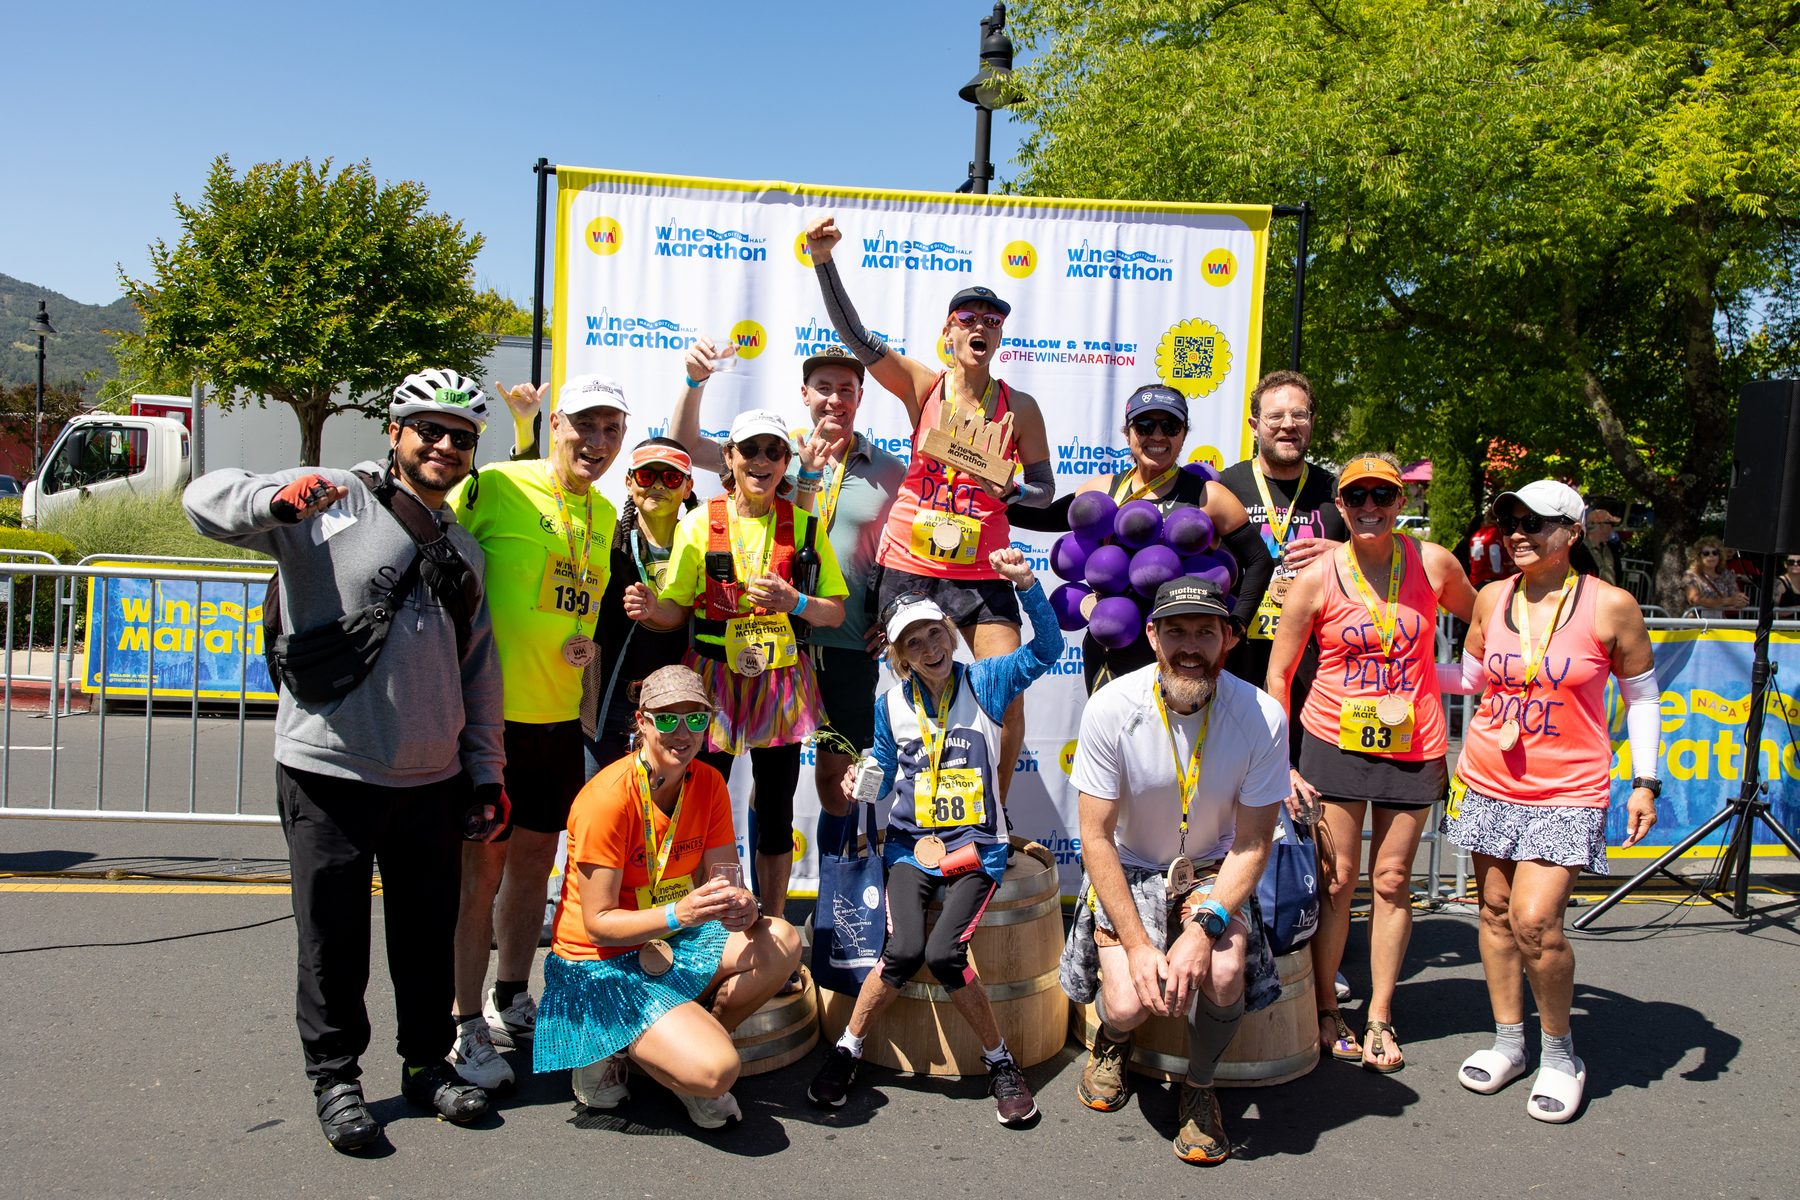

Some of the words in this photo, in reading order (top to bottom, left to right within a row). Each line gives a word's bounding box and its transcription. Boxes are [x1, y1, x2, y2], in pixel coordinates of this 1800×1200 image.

[723, 231, 747, 241] EDITION
[1000, 337, 1061, 349] FOLLOW
[1066, 339, 1077, 350] &
[1083, 340, 1111, 351] TAG
[1114, 342, 1138, 353] US!
[999, 350, 1136, 367] @THEWINEMARATHON
[1056, 459, 1132, 476] Marath
[918, 476, 985, 519] PACE
[1245, 504, 1266, 514] win
[554, 584, 590, 616] 139
[1169, 586, 1208, 597] mothers
[713, 602, 738, 614] NATHAN
[117, 625, 264, 655] Marat
[1343, 656, 1417, 692] PACE
[1489, 693, 1564, 737] PACE
[1697, 697, 1737, 718] NAPA
[944, 737, 972, 750] VALLEY
[1360, 725, 1393, 748] 83
[935, 795, 966, 822] 68
[670, 840, 703, 855] RUNNERS
[653, 888, 689, 904] arathon
